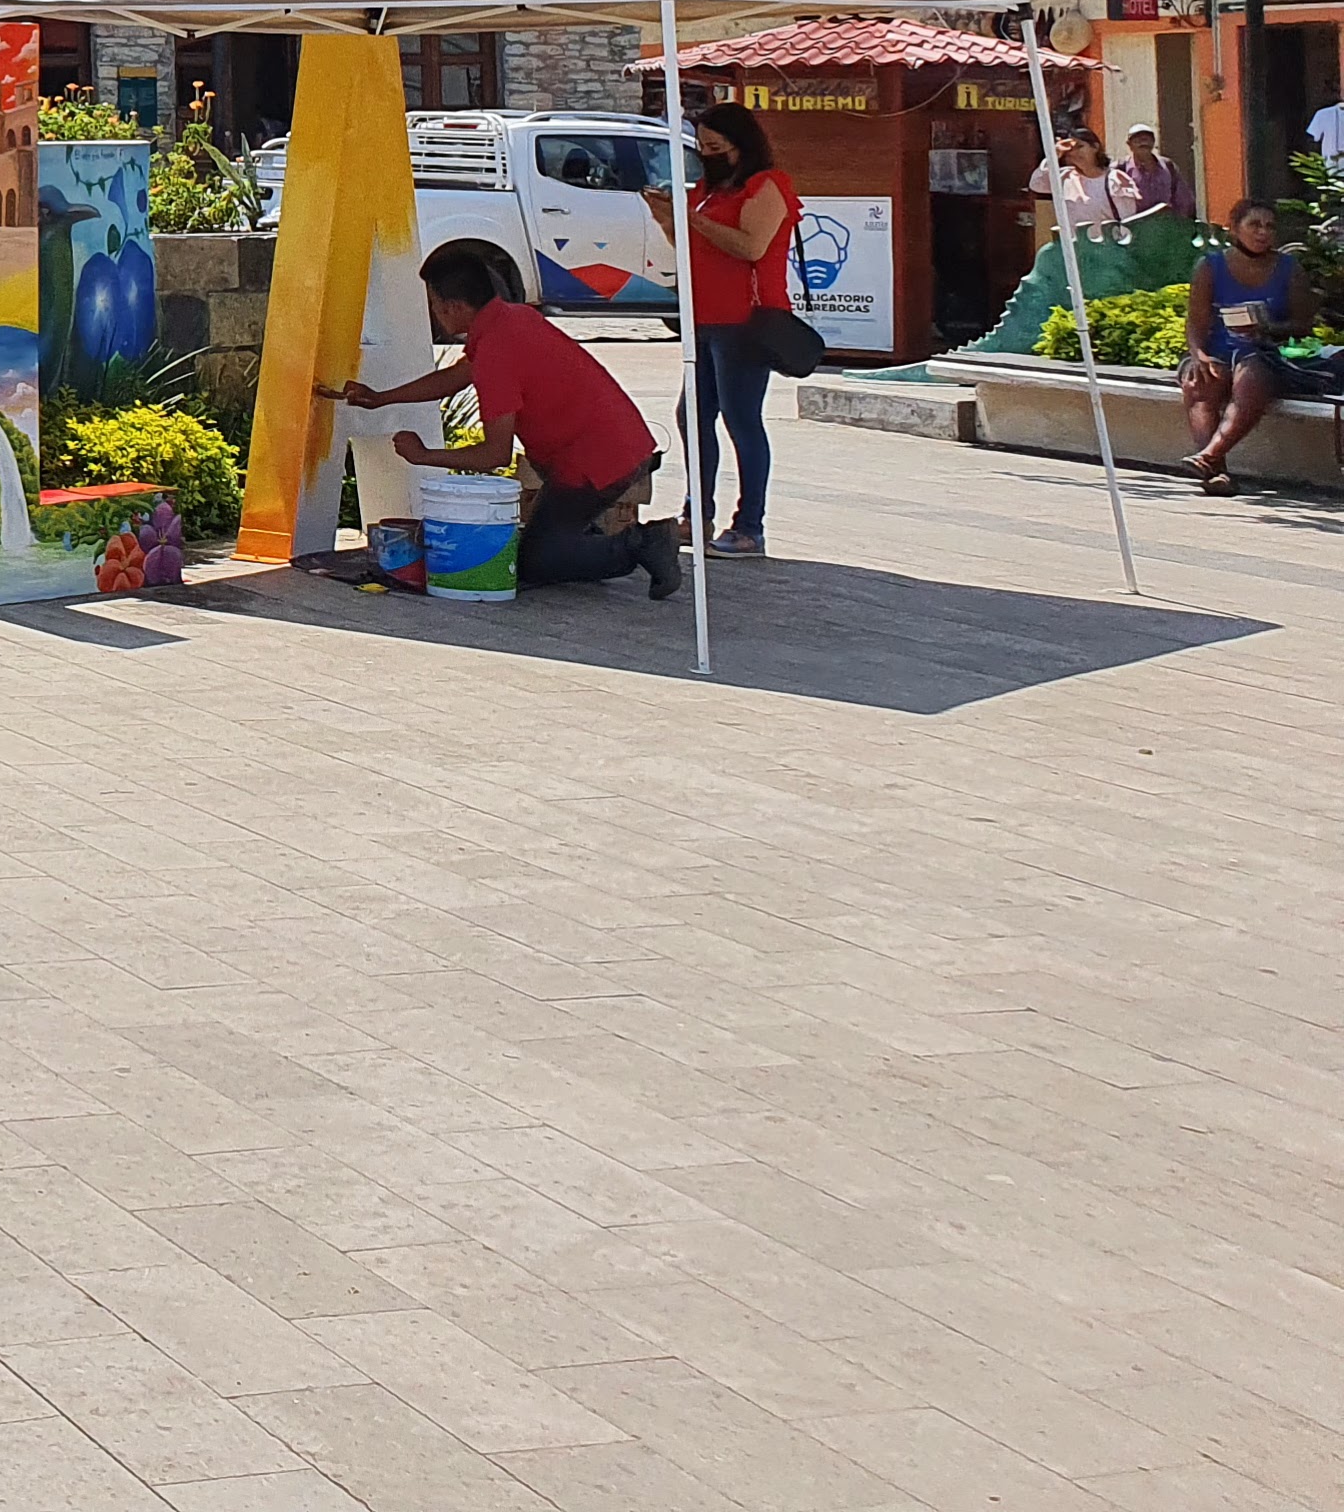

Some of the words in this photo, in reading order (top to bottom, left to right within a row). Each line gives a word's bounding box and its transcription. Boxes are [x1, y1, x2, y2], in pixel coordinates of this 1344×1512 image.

[771, 95, 867, 111] TURISMO
[984, 96, 1038, 112] TURIS
[793, 292, 874, 304] OLIGATORIO
[791, 302, 871, 314] UREBOCAS
